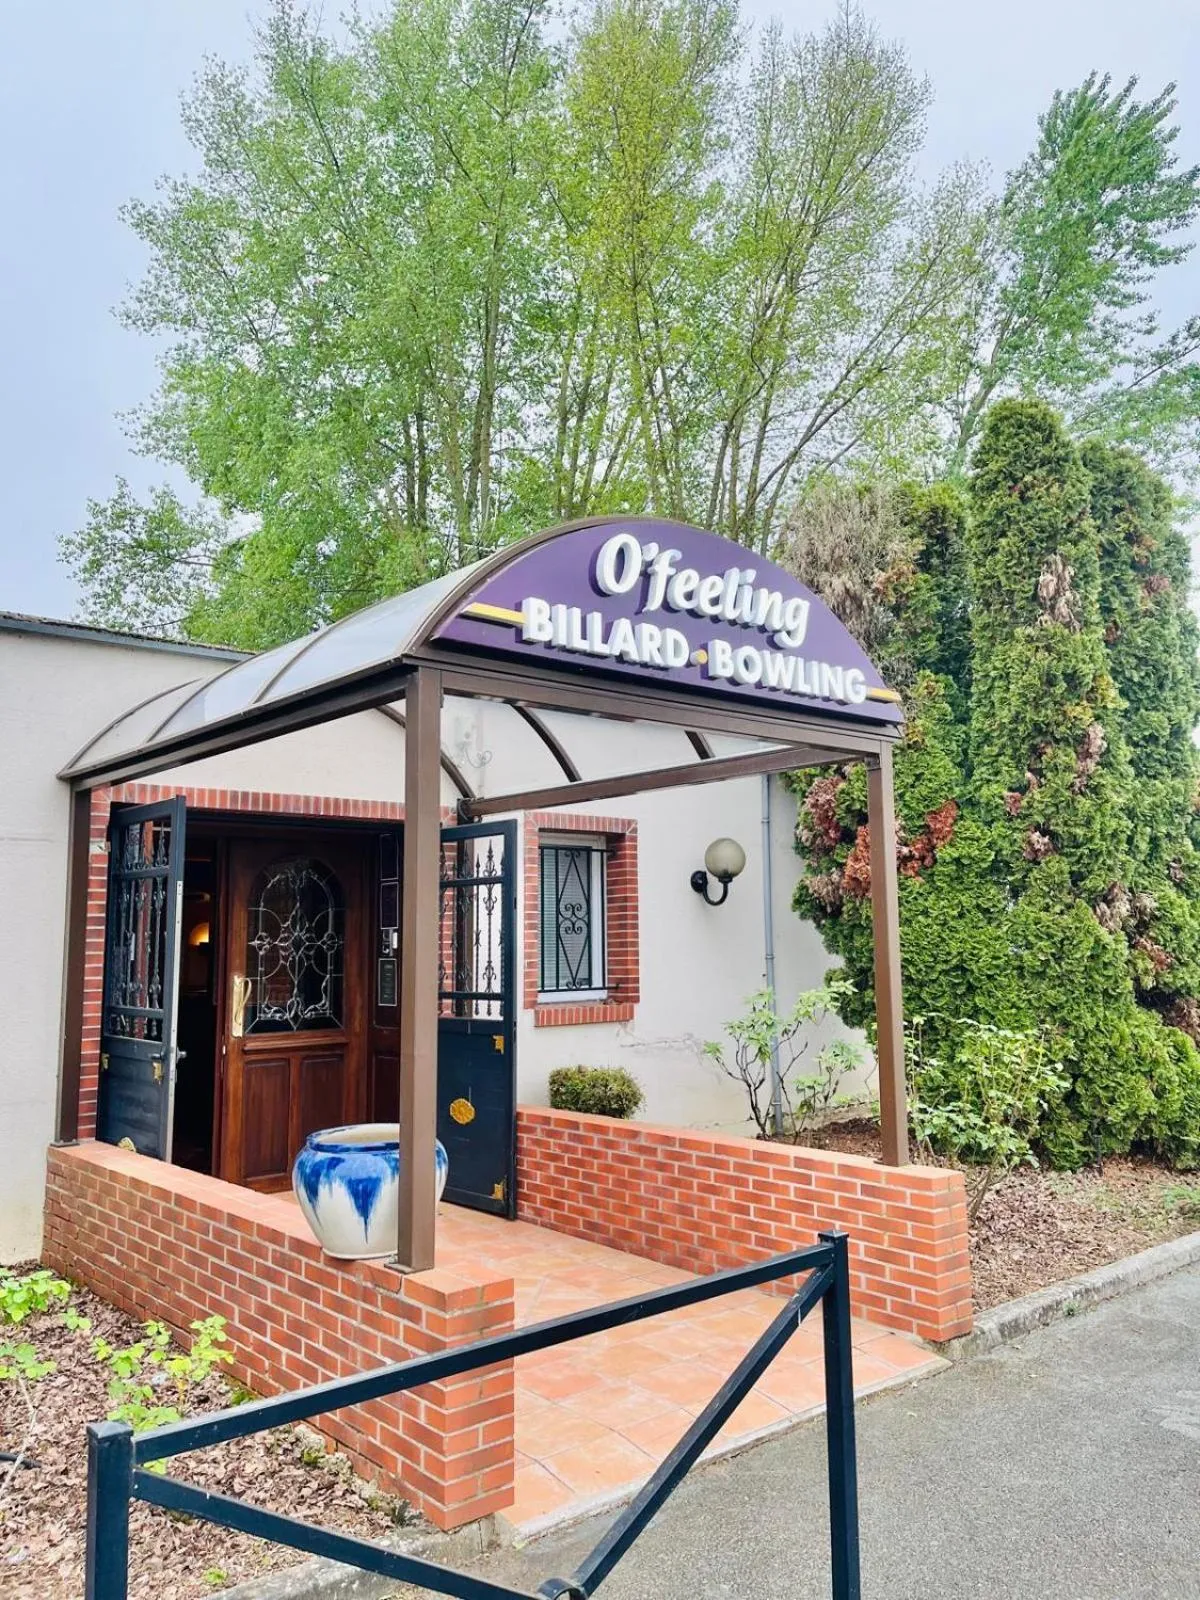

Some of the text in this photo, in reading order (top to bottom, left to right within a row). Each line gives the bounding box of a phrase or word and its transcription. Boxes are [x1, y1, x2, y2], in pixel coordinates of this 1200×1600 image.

[597, 533, 810, 648] O'feeling
[521, 597, 867, 704] BILLARD BOWLING
